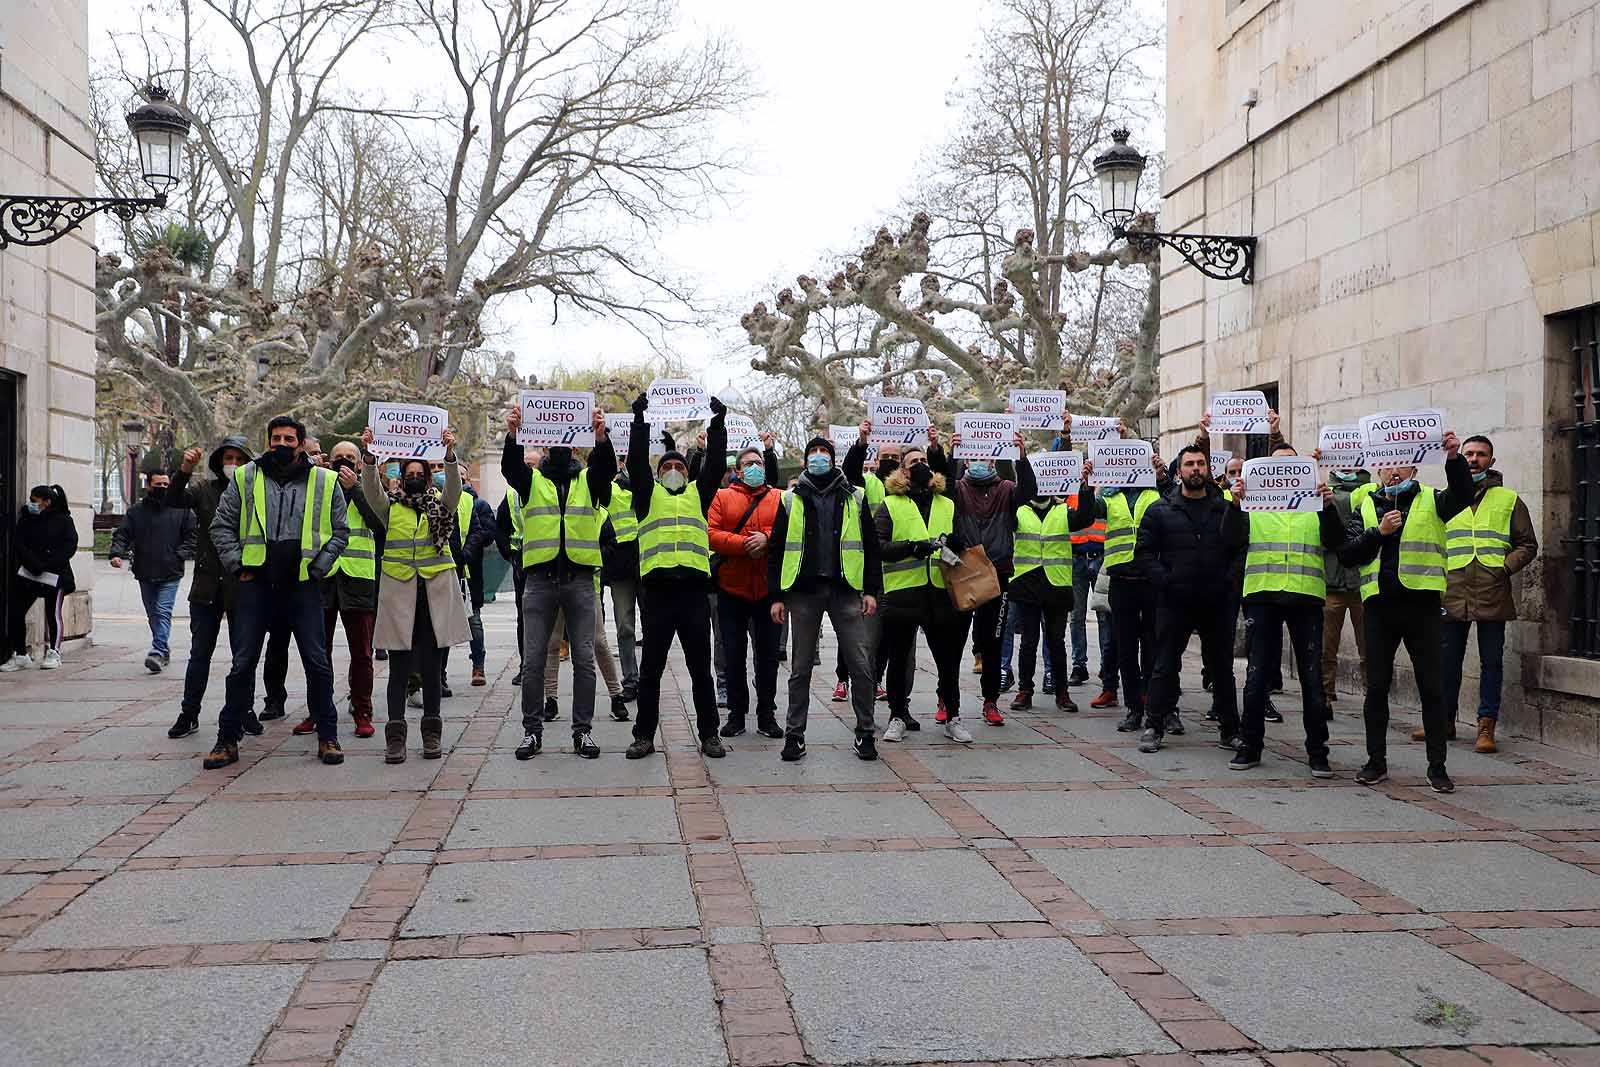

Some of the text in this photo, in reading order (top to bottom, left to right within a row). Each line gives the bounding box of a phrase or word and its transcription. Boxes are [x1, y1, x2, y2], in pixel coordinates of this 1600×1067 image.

[651, 387, 704, 396] ACUERDO
[661, 397, 696, 405] JUSTO
[1016, 395, 1059, 404] ACUERDO
[1215, 398, 1263, 407] ACUERDO
[526, 399, 585, 411] ACUERDO
[1023, 405, 1051, 413] JUSTO
[876, 405, 923, 415] ACUERDO
[1222, 407, 1254, 415] JUSTO
[379, 411, 439, 425] ACUERDO
[535, 412, 575, 422] JUSTO
[883, 416, 915, 425] JUSTO
[963, 421, 1011, 430] ACUERDO
[1372, 418, 1437, 431] ACUERDO
[388, 424, 428, 436] JUSTO
[543, 428, 563, 436] Local
[971, 431, 1002, 439] JUSTO
[1384, 430, 1427, 442] JUSTO
[395, 440, 415, 449] Local
[1097, 447, 1146, 456] ACUERDO
[1395, 447, 1414, 456] Local
[1033, 459, 1076, 468] ACUERDO
[1105, 458, 1137, 466] JUSTO
[1040, 468, 1069, 477] JUSTO
[1250, 465, 1311, 476] ACUERDO
[1260, 478, 1300, 488] JUSTO
[995, 591, 1009, 638] GIVOVA
